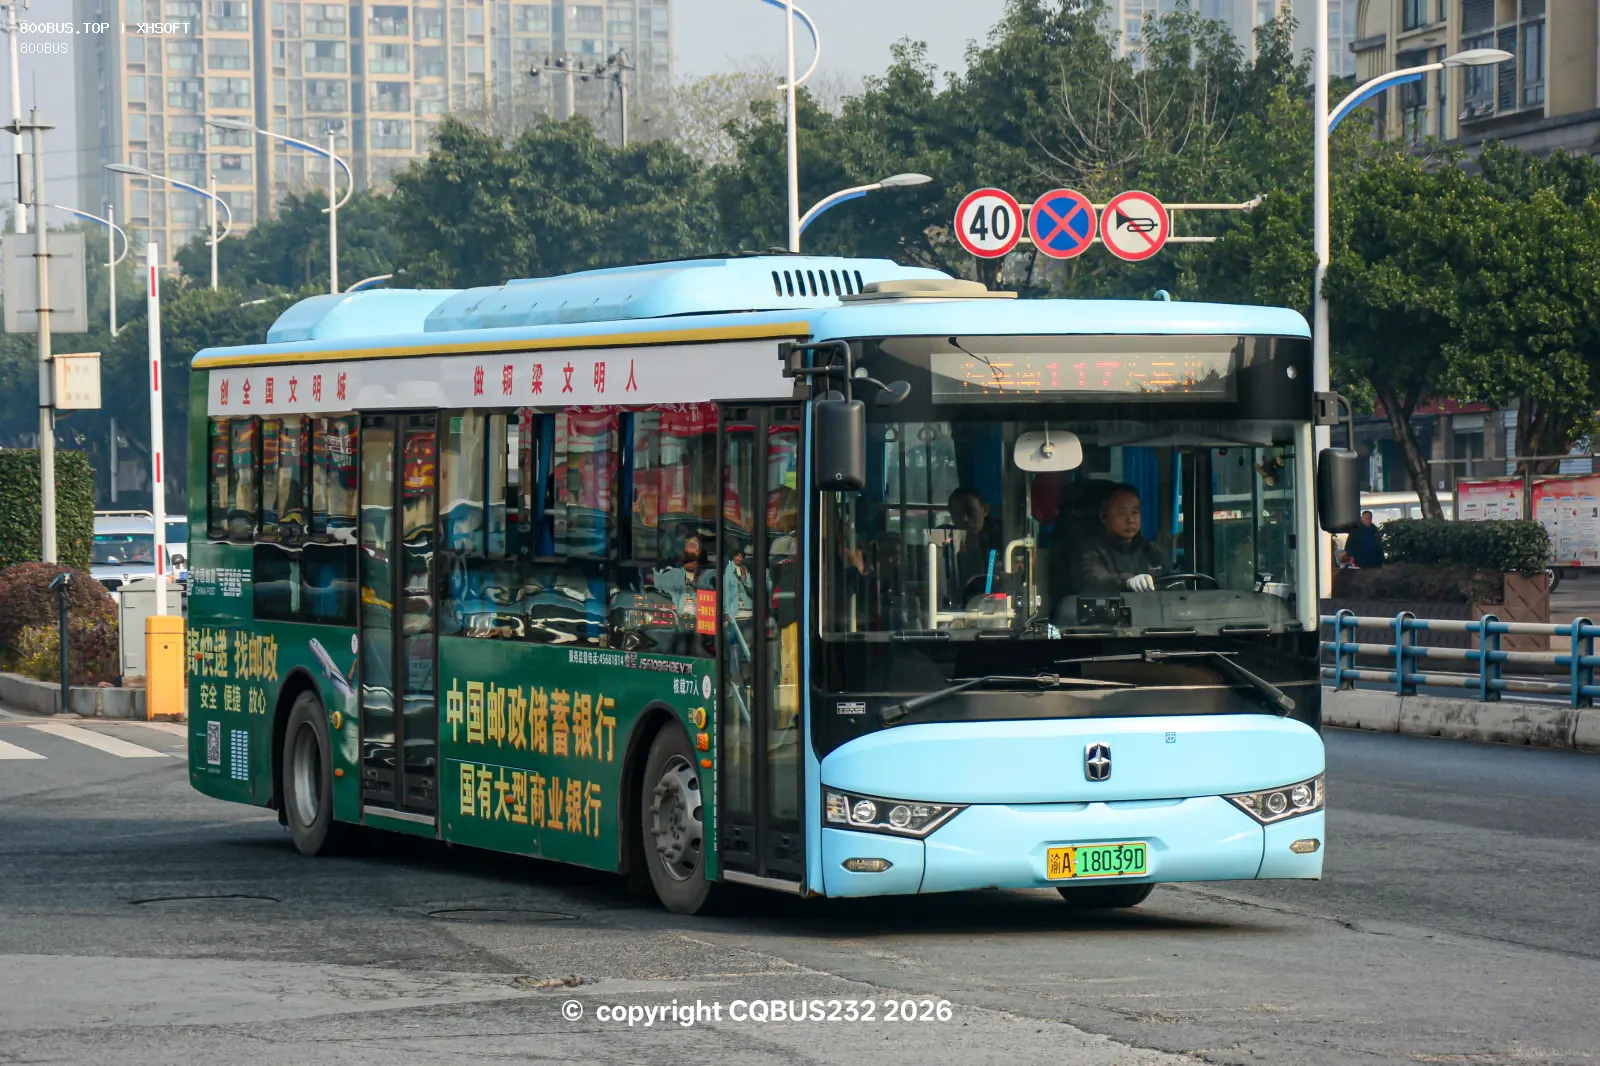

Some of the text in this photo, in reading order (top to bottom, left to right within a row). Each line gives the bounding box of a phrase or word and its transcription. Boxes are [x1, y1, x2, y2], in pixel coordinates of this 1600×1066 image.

[969, 205, 1010, 240] 40
[220, 372, 346, 405] 创全国文明城
[473, 359, 637, 396] 做铜梁文明人
[187, 627, 278, 682] 寄快递 找邮政
[200, 682, 267, 715] 安全 便捷 放心
[673, 678, 699, 696] 核载77人
[446, 677, 616, 765] 中国邮政储蓄银行
[460, 762, 602, 838] 国有大型商业银行
